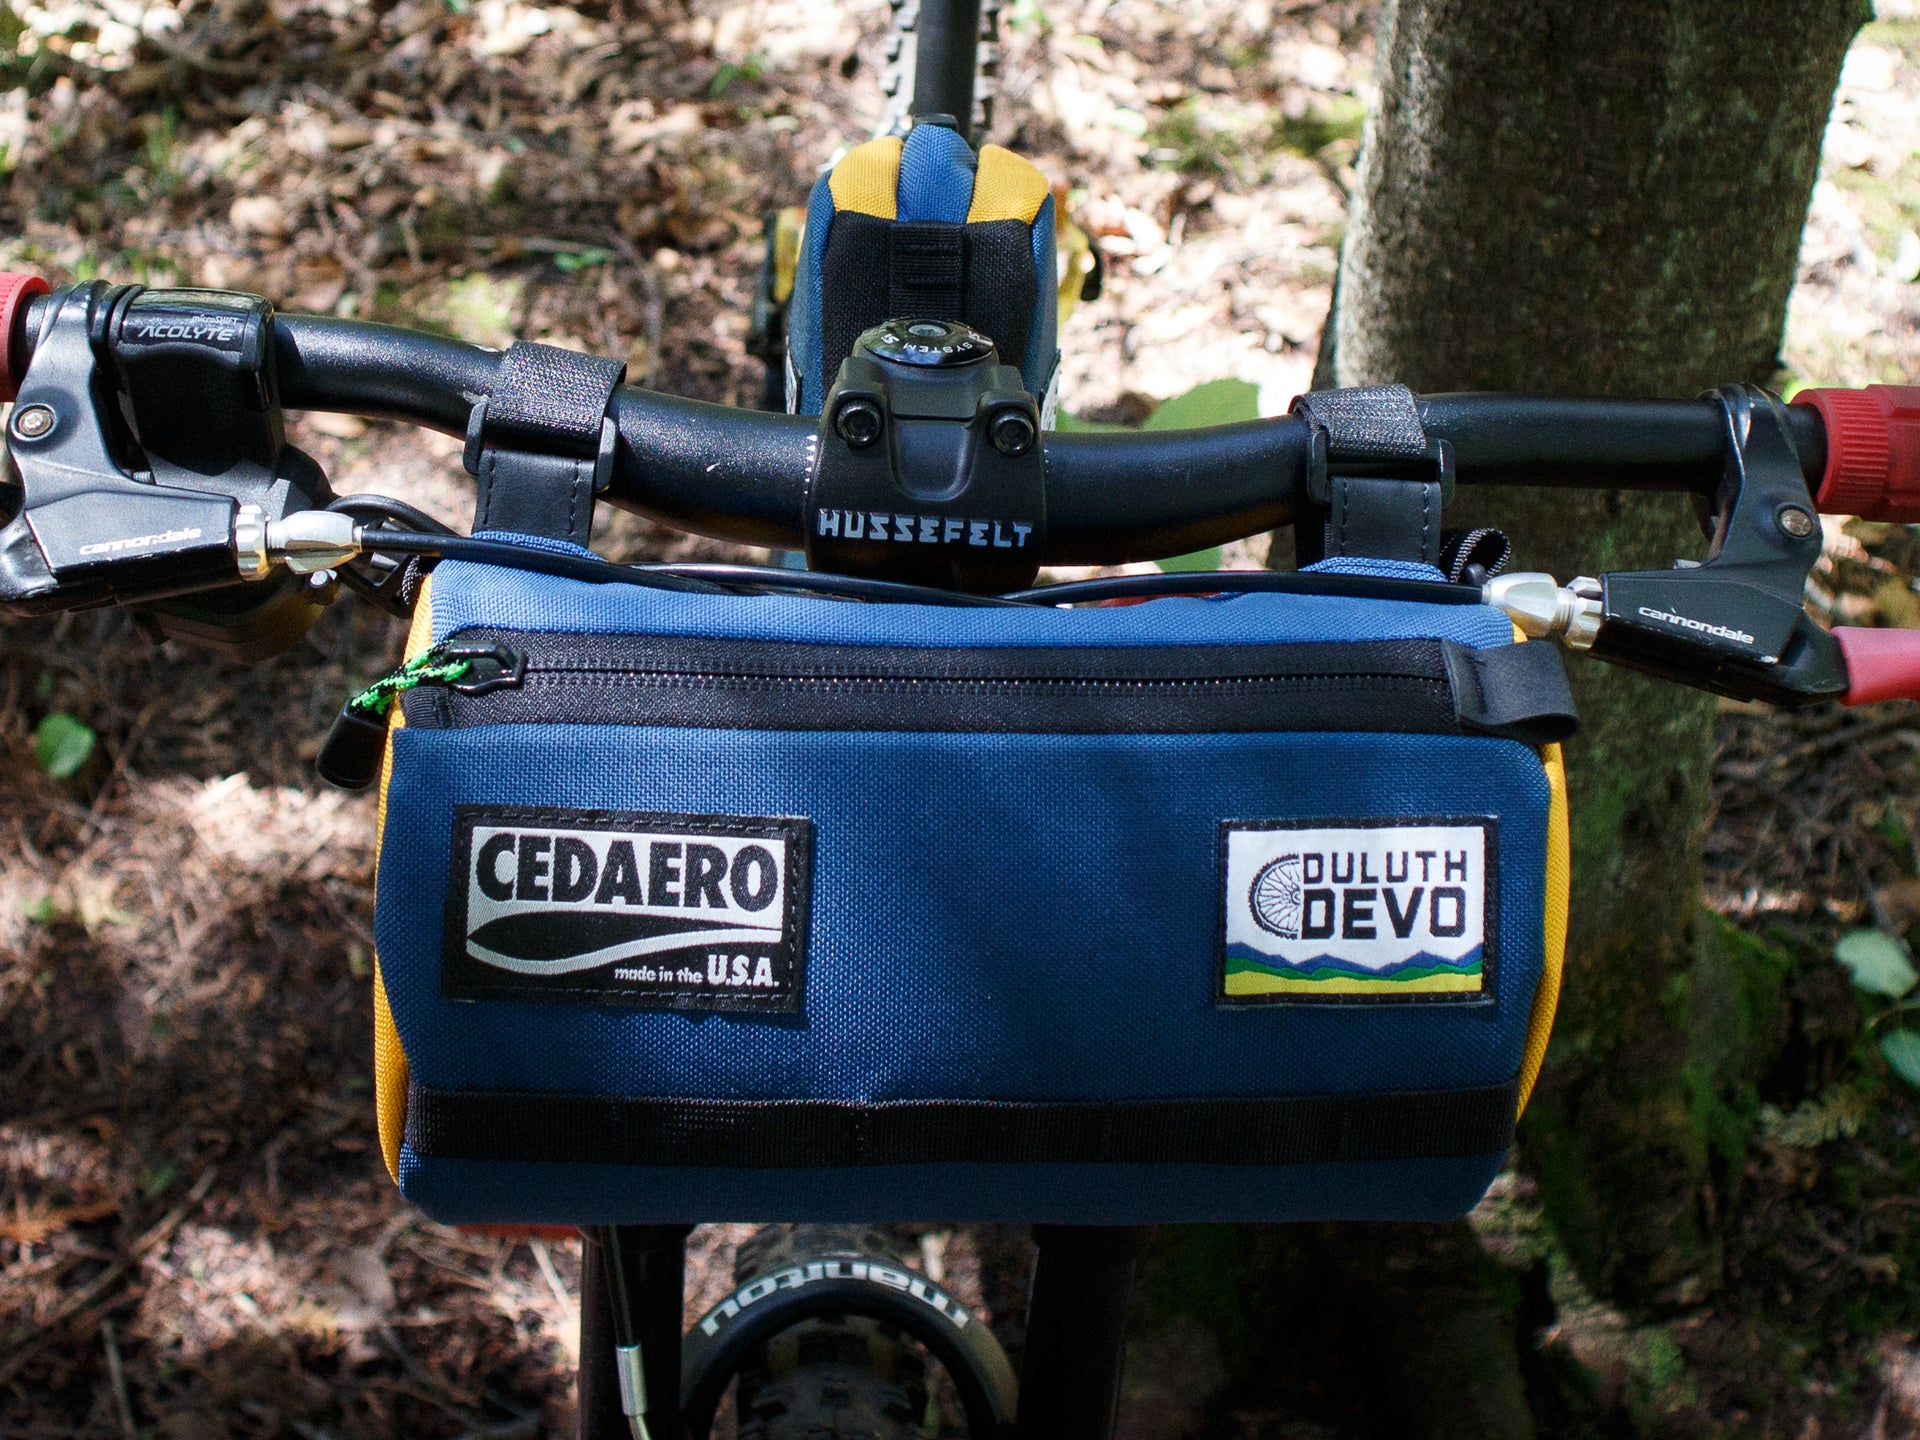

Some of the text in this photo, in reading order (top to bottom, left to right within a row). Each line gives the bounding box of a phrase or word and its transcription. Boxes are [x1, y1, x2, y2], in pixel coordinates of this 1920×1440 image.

[138, 325, 235, 341] ACOLYTE
[903, 341, 974, 354] SYSTEM
[79, 526, 202, 556] cannondale
[818, 509, 1033, 548] HUSSEFELT
[1638, 606, 1755, 645] cannondale
[475, 832, 779, 913] CEDAERO
[1303, 850, 1468, 885] DULUTH
[1301, 887, 1467, 940] DEVO
[614, 954, 780, 987] made in the U.S.A.
[700, 1260, 969, 1337] manitou
